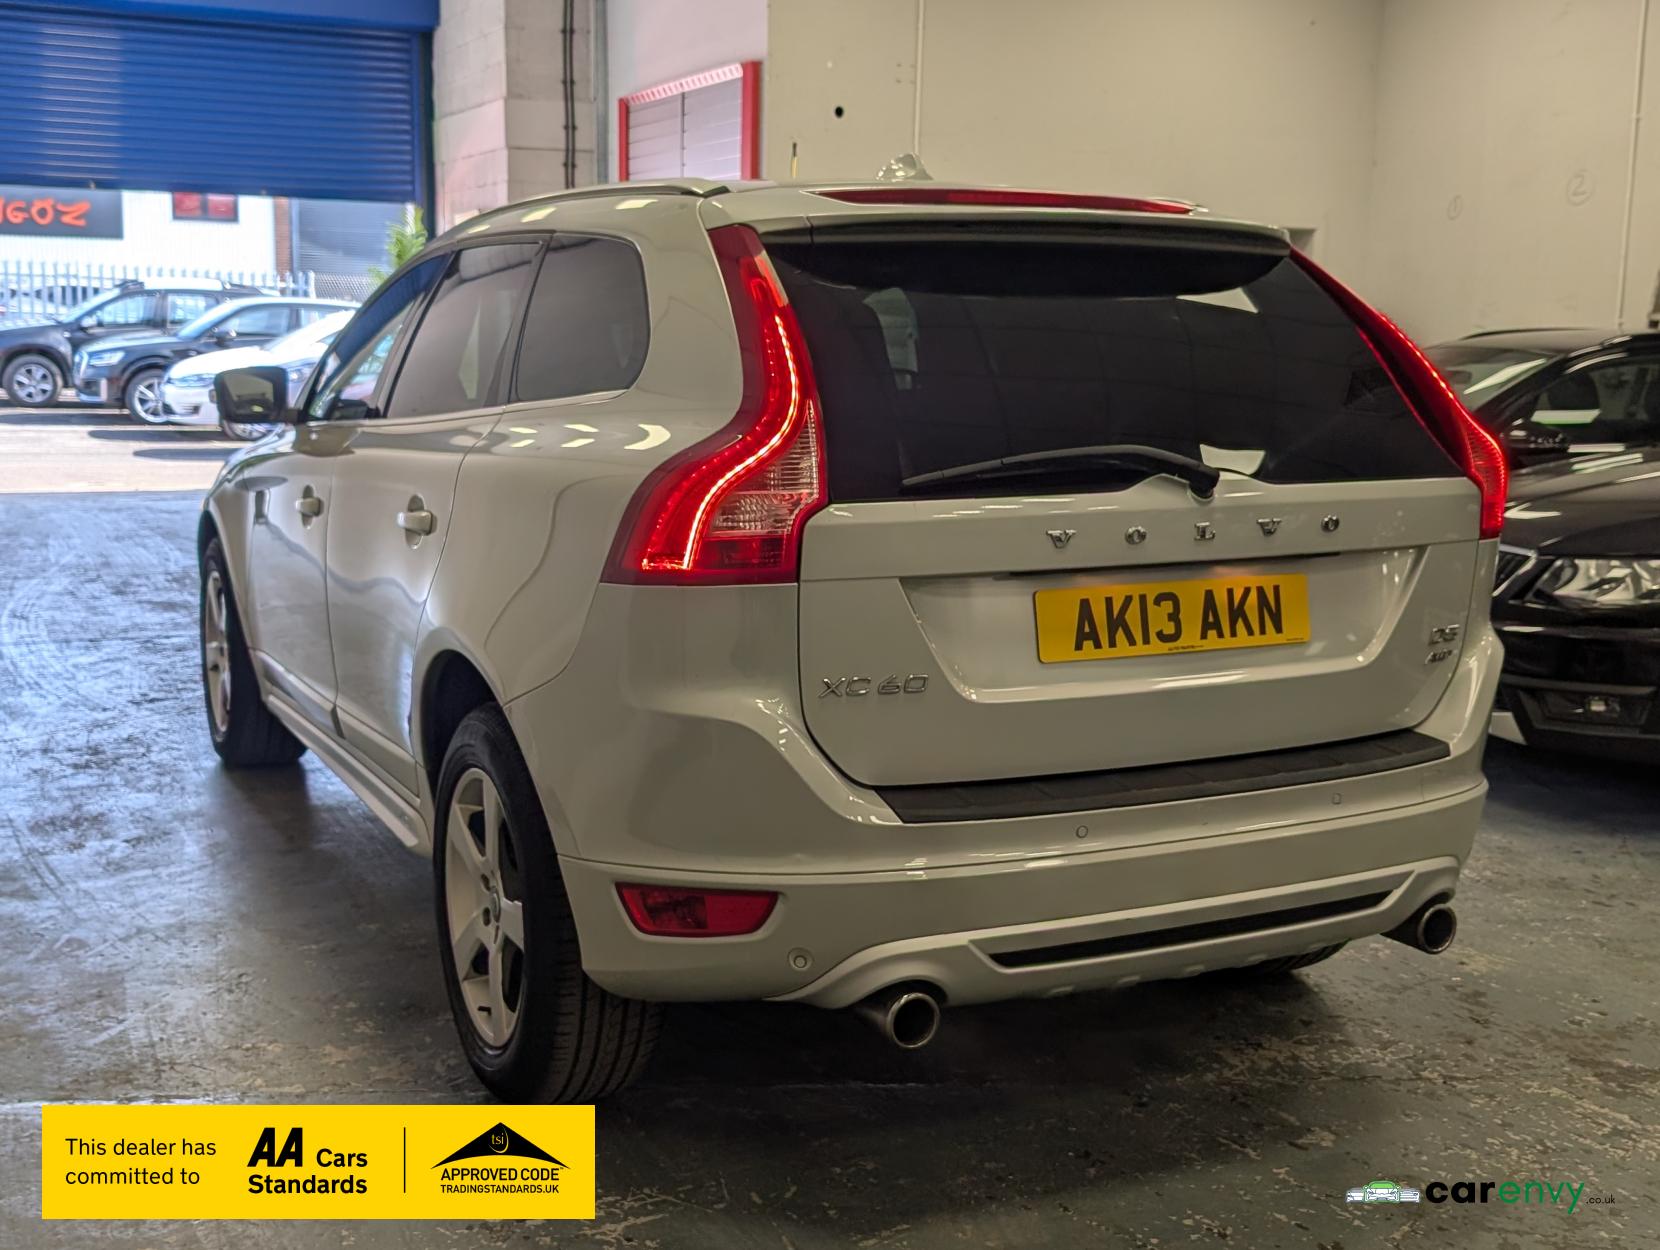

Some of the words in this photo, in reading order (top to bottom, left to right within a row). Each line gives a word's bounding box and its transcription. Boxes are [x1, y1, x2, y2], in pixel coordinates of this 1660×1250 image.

[1046, 514, 1341, 549] VOLVO
[1074, 591, 1183, 652] AK13
[1199, 584, 1284, 641] AKN
